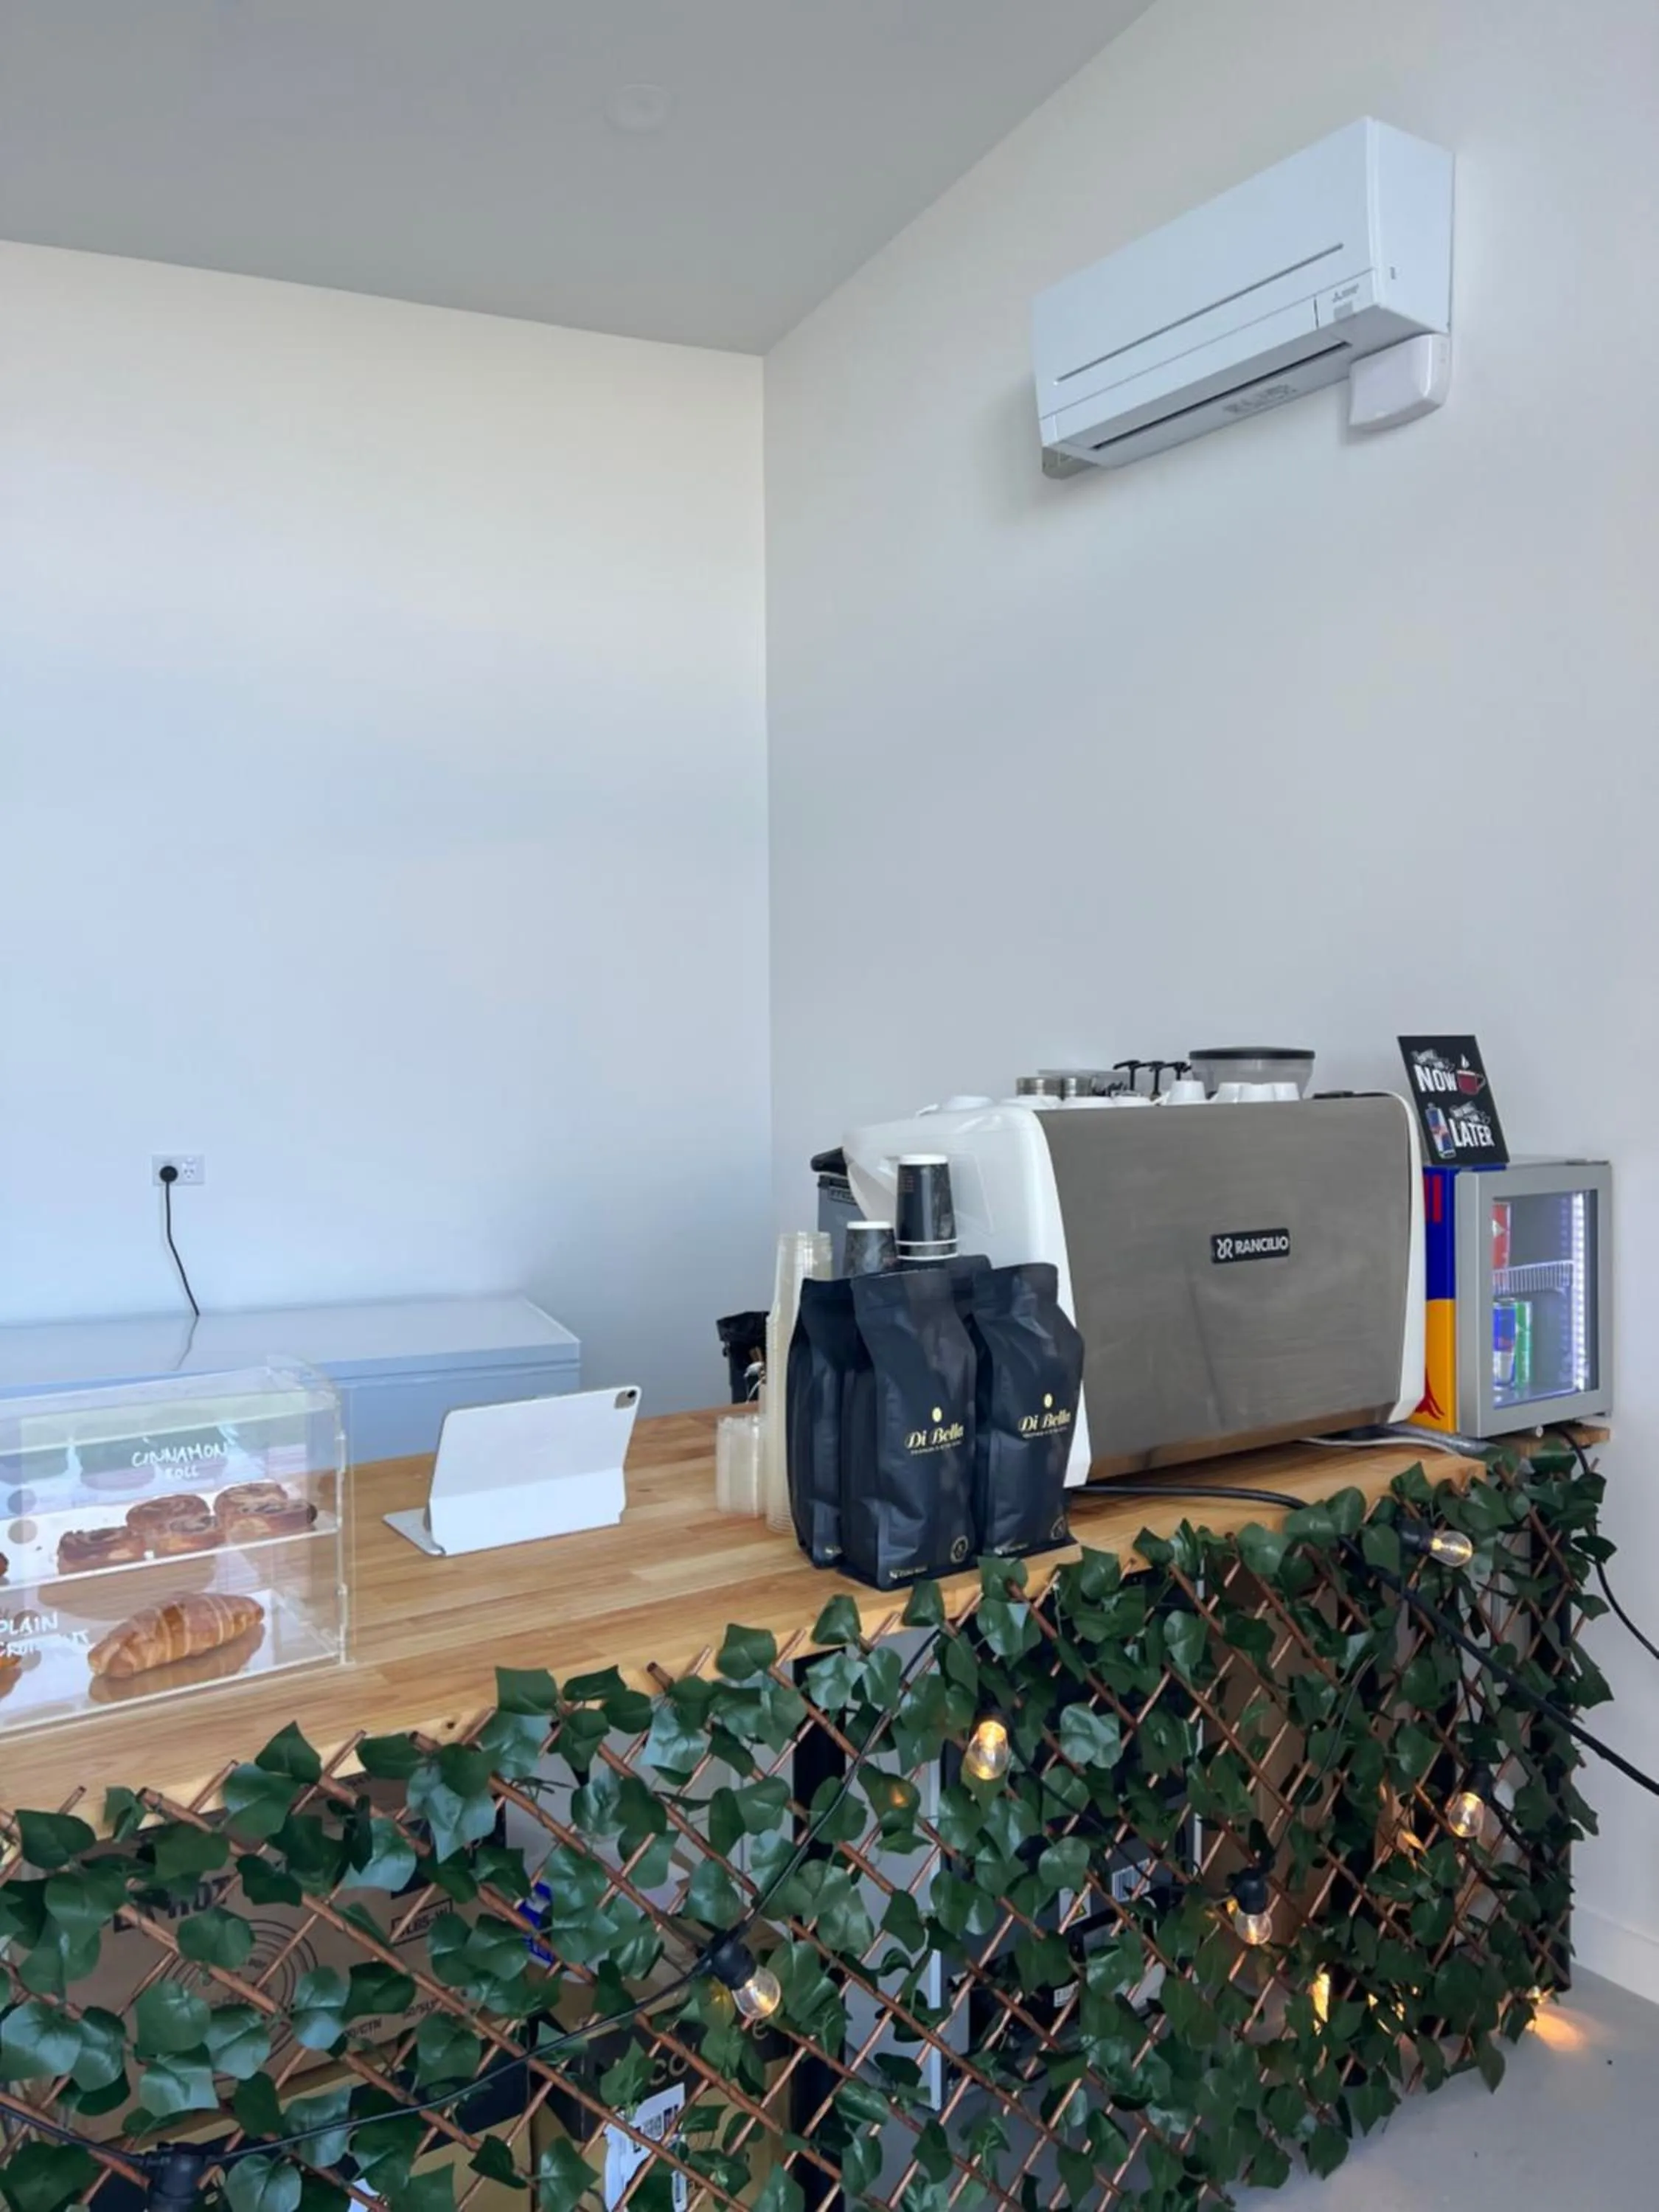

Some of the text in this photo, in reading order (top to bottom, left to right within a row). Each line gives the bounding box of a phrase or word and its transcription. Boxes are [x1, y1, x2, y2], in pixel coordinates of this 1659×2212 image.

[1413, 1064, 1458, 1093] NOW
[1448, 1118, 1495, 1147] LATER
[1234, 1236, 1289, 1254] RANCILIO
[1018, 1409, 1071, 1431] Di Bella
[905, 1430, 927, 1449] Di
[931, 1422, 964, 1445] Bella
[131, 1442, 228, 1467] CINNAMON
